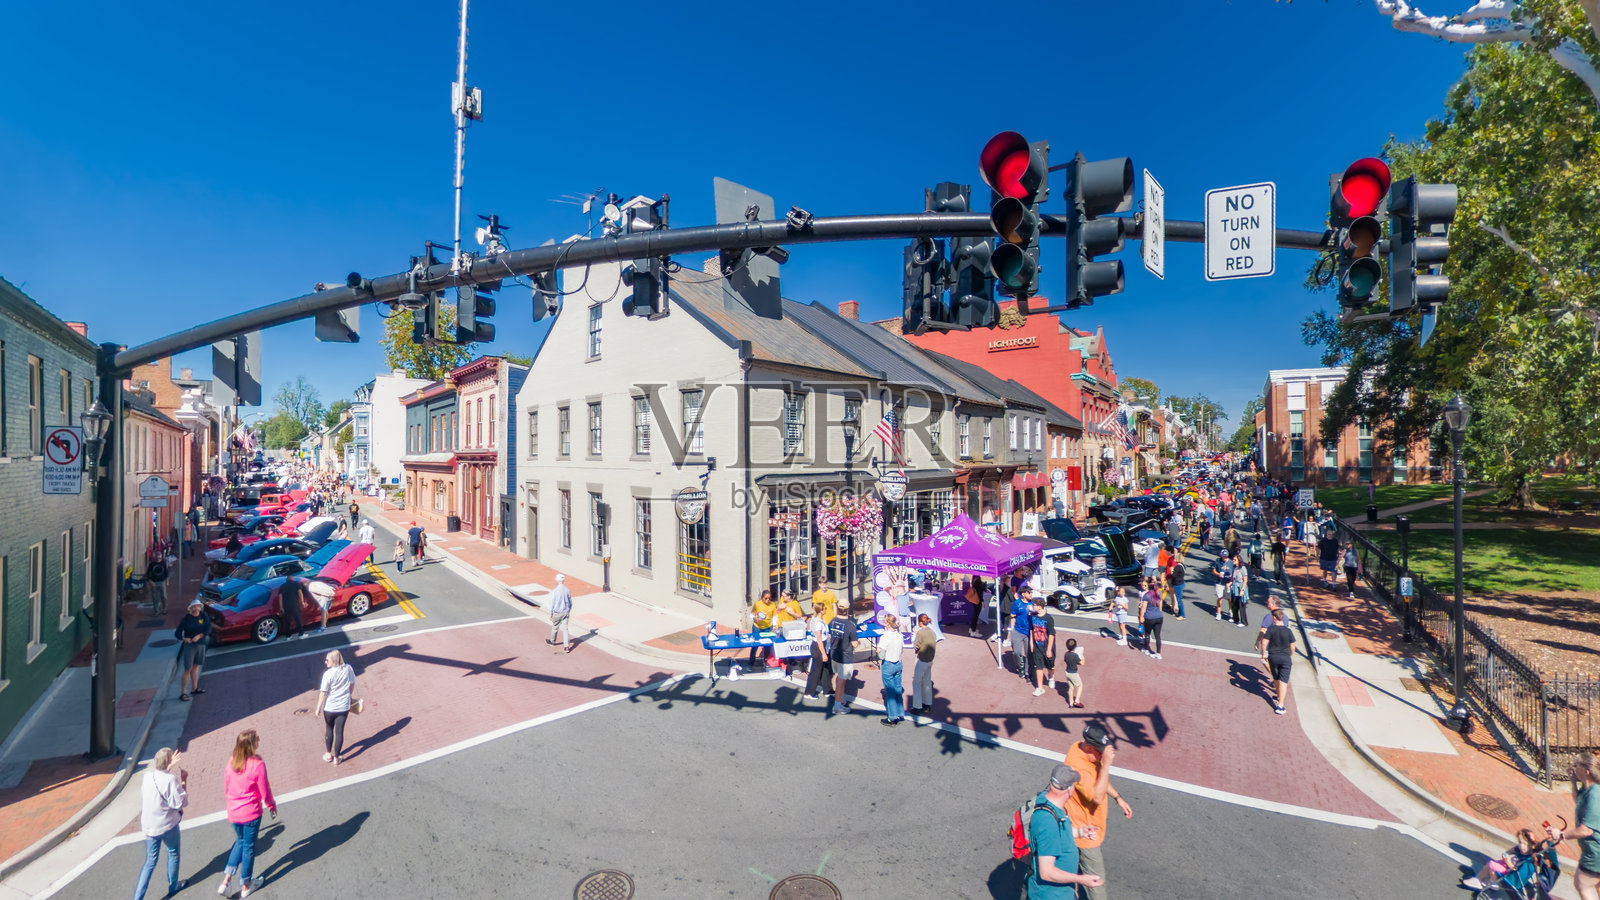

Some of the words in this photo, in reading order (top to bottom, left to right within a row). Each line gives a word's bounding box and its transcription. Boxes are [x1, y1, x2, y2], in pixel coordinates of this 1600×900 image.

[1225, 194, 1254, 212] NO
[1221, 215, 1260, 232] TURN
[1230, 236, 1250, 250] ON
[1226, 256, 1254, 270] RED
[988, 336, 1037, 349] LIGHTFOOT
[1300, 498, 1312, 506] 20
